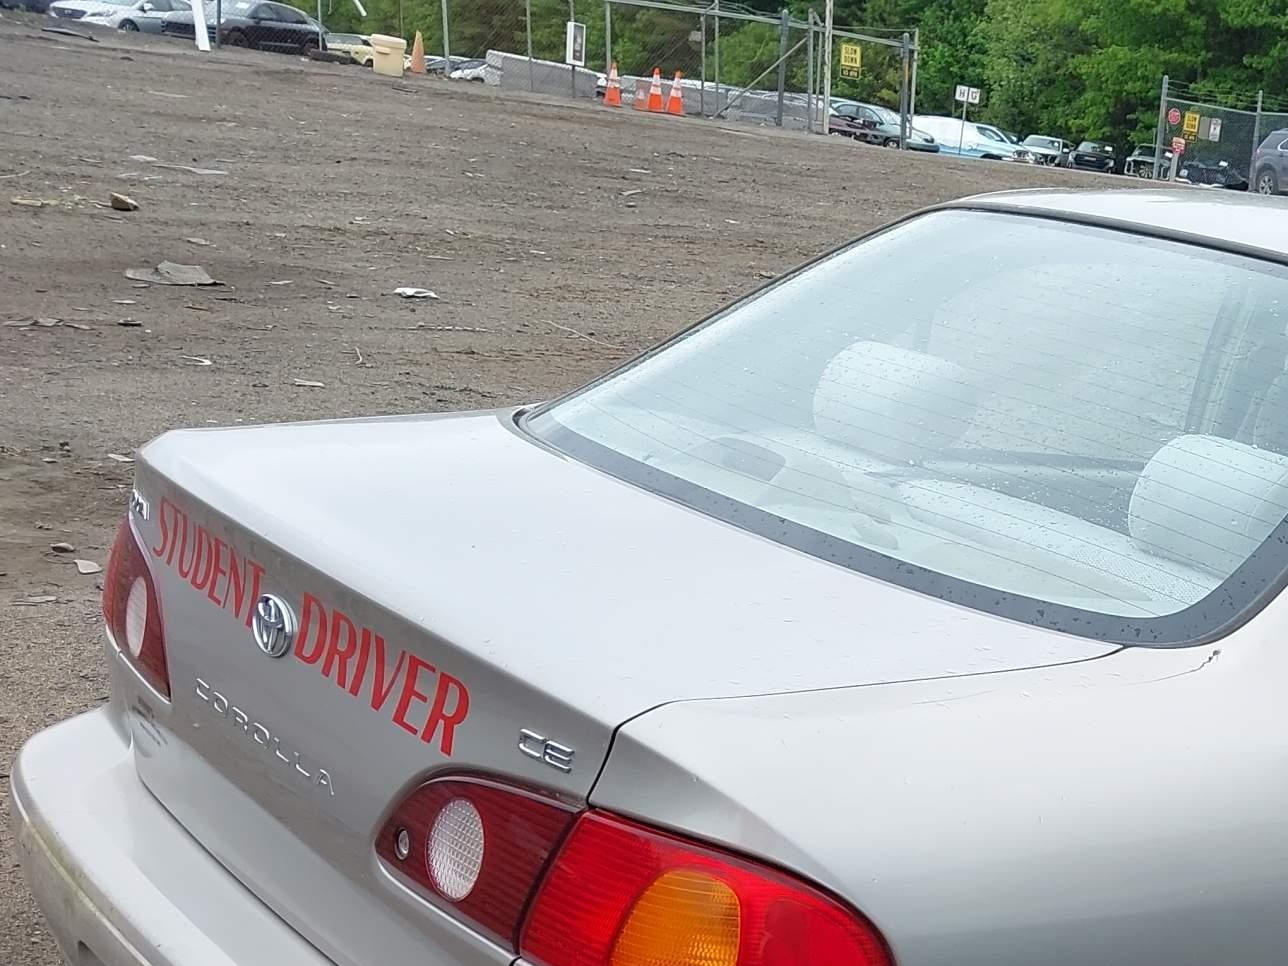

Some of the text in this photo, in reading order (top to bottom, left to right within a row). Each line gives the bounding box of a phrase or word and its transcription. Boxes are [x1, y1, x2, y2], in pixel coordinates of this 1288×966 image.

[152, 496, 470, 757] STUDENT DRIVER
[196, 677, 335, 796] COROLLA
[519, 728, 575, 774] CE
